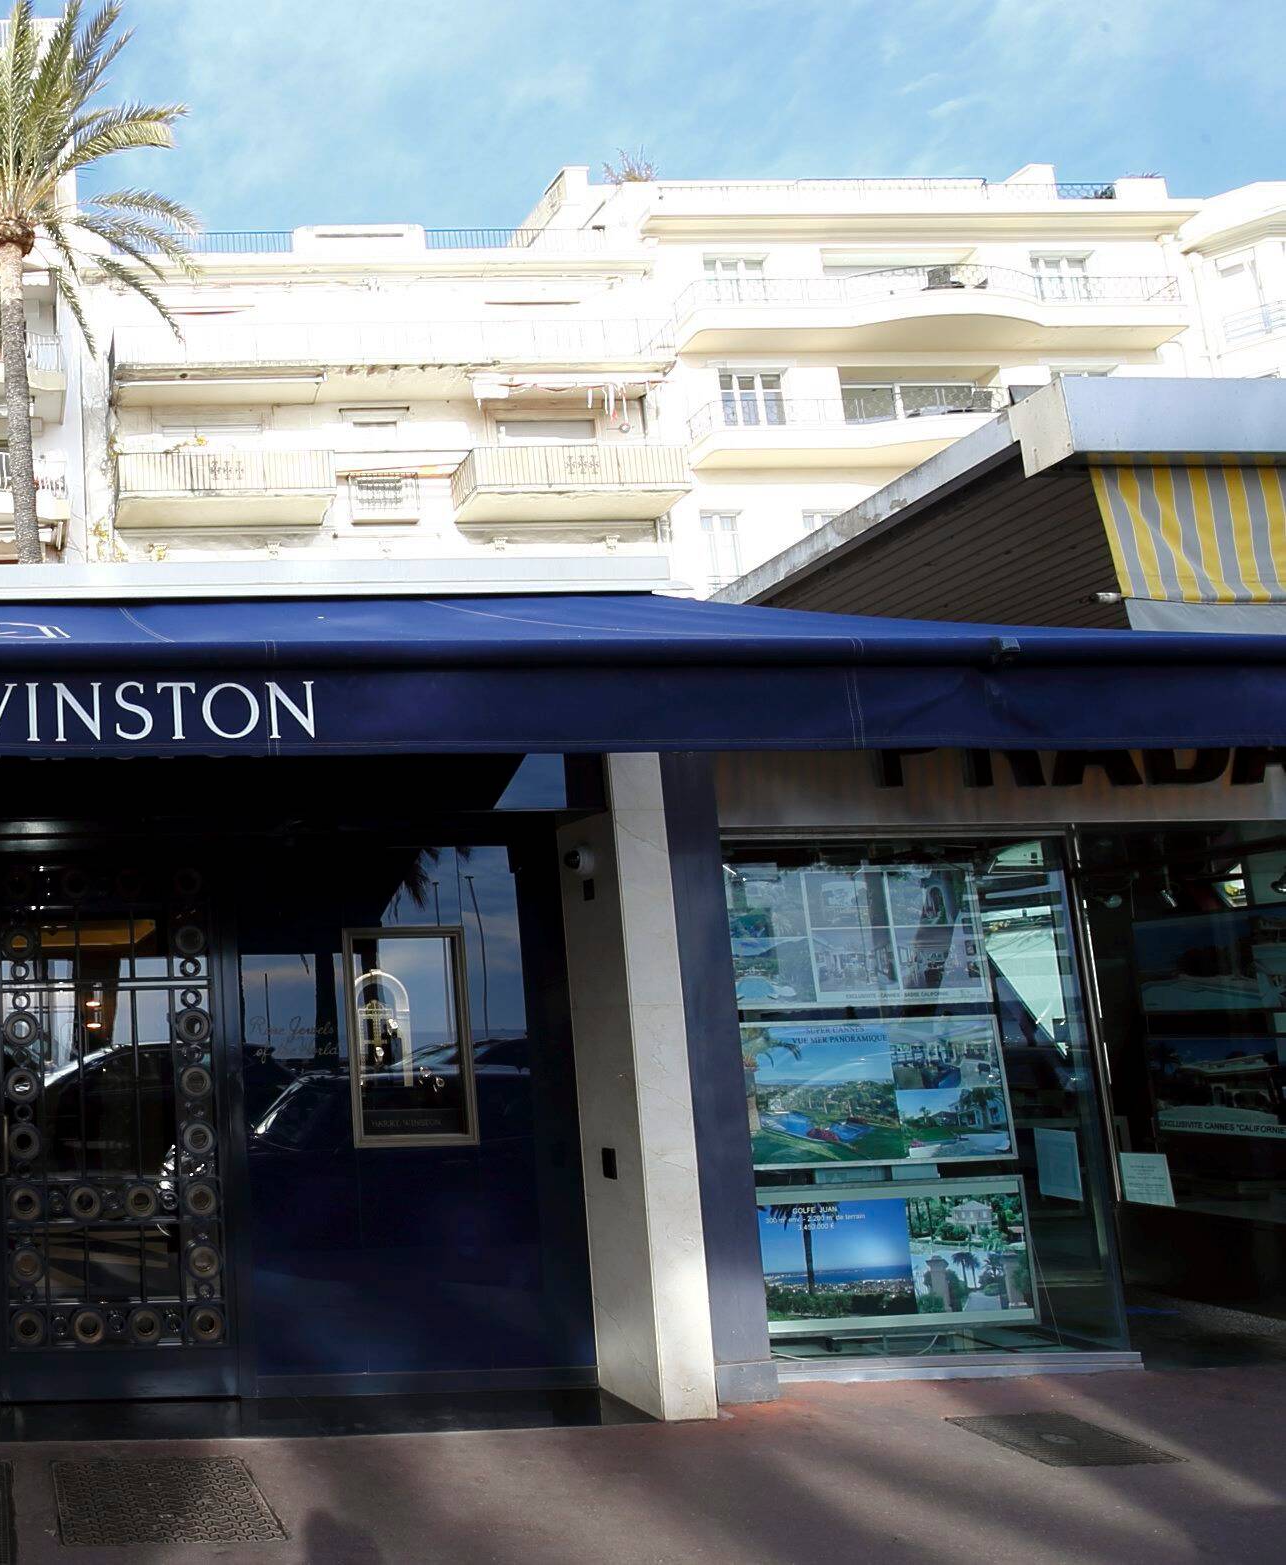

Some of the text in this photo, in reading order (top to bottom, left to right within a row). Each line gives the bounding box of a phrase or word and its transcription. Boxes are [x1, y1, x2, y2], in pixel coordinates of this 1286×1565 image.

[832, 1025, 865, 1033] CANNES
[792, 1034, 888, 1045] VUE MER PANORAMIQUE
[253, 1041, 271, 1064] of
[1160, 1119, 1203, 1129] EXCLUSIVITE
[1204, 1120, 1235, 1132] CANNES
[792, 1206, 816, 1214] GOLFE
